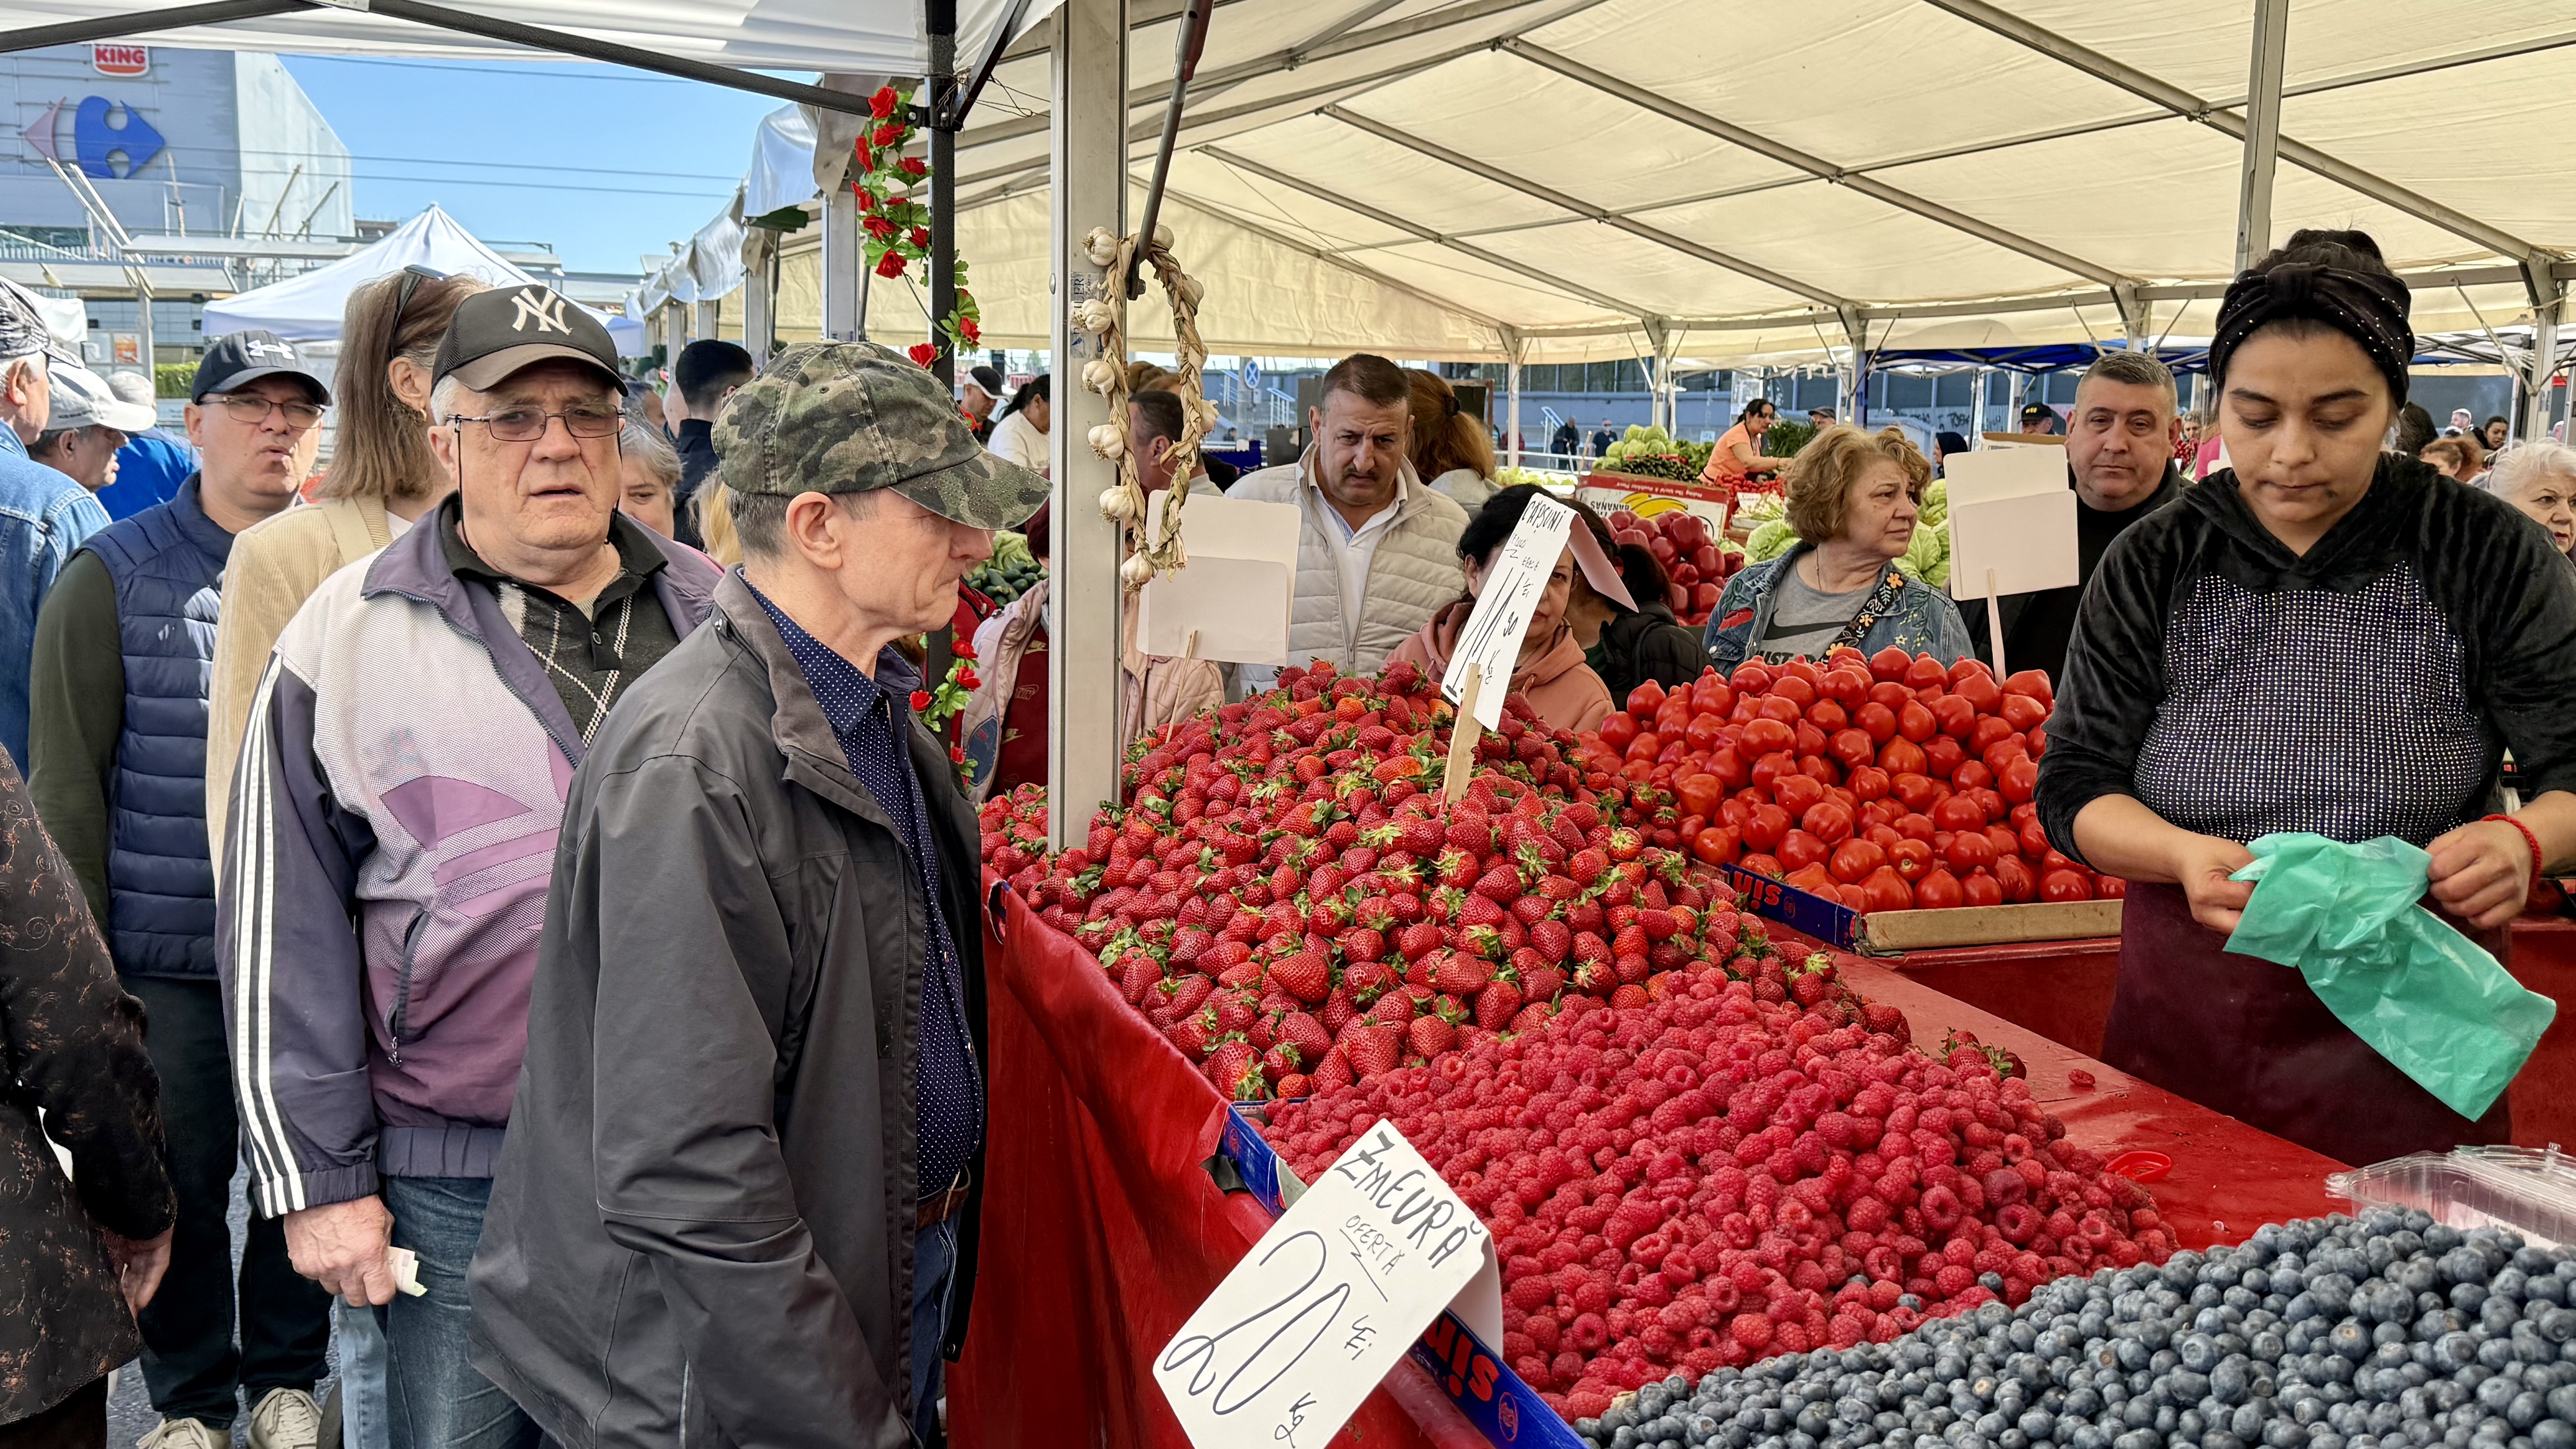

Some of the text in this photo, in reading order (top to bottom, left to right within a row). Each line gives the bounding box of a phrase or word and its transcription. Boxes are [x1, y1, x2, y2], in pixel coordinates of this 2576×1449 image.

[95, 48, 145, 64] KING
[511, 288, 571, 336] NY
[1590, 501, 1629, 511] BANANAS
[1333, 1130, 1481, 1269] ZMEURĂ
[1346, 1214, 1406, 1274] OFERTĂ
[1164, 1231, 1350, 1415] 20
